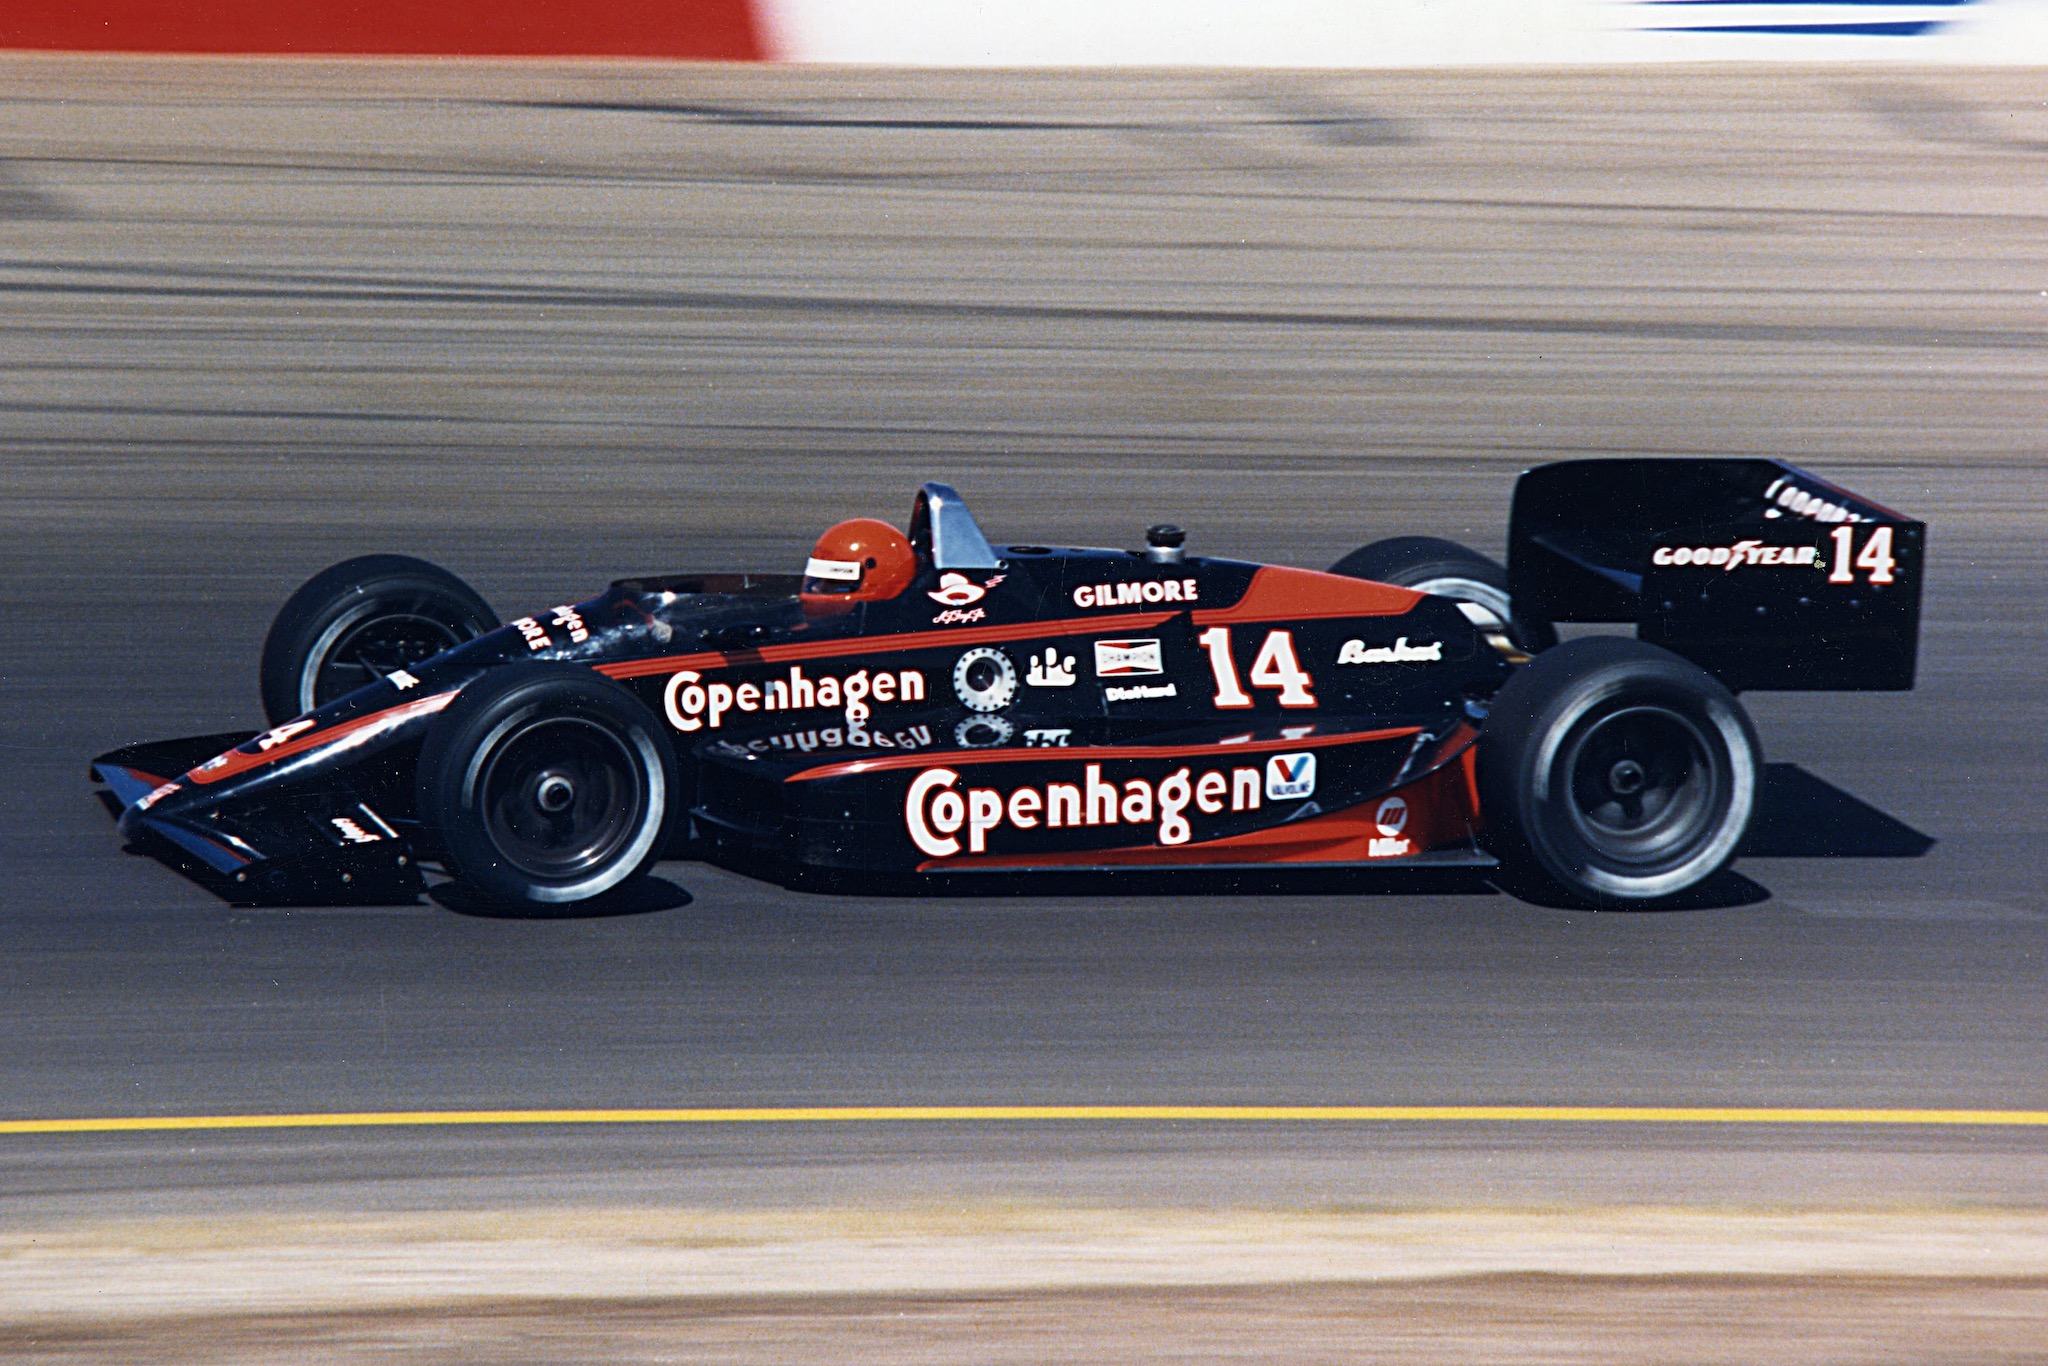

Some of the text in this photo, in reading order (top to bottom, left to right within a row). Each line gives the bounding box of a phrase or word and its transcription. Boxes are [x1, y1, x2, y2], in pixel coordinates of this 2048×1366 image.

[1653, 540, 1816, 571] GOODYEAR
[1829, 525, 1896, 584] 14
[1073, 579, 1198, 608] GILMORE
[1199, 625, 1316, 708] 14
[663, 666, 925, 732] Copenhagen
[905, 762, 1261, 857] Copenhagen
